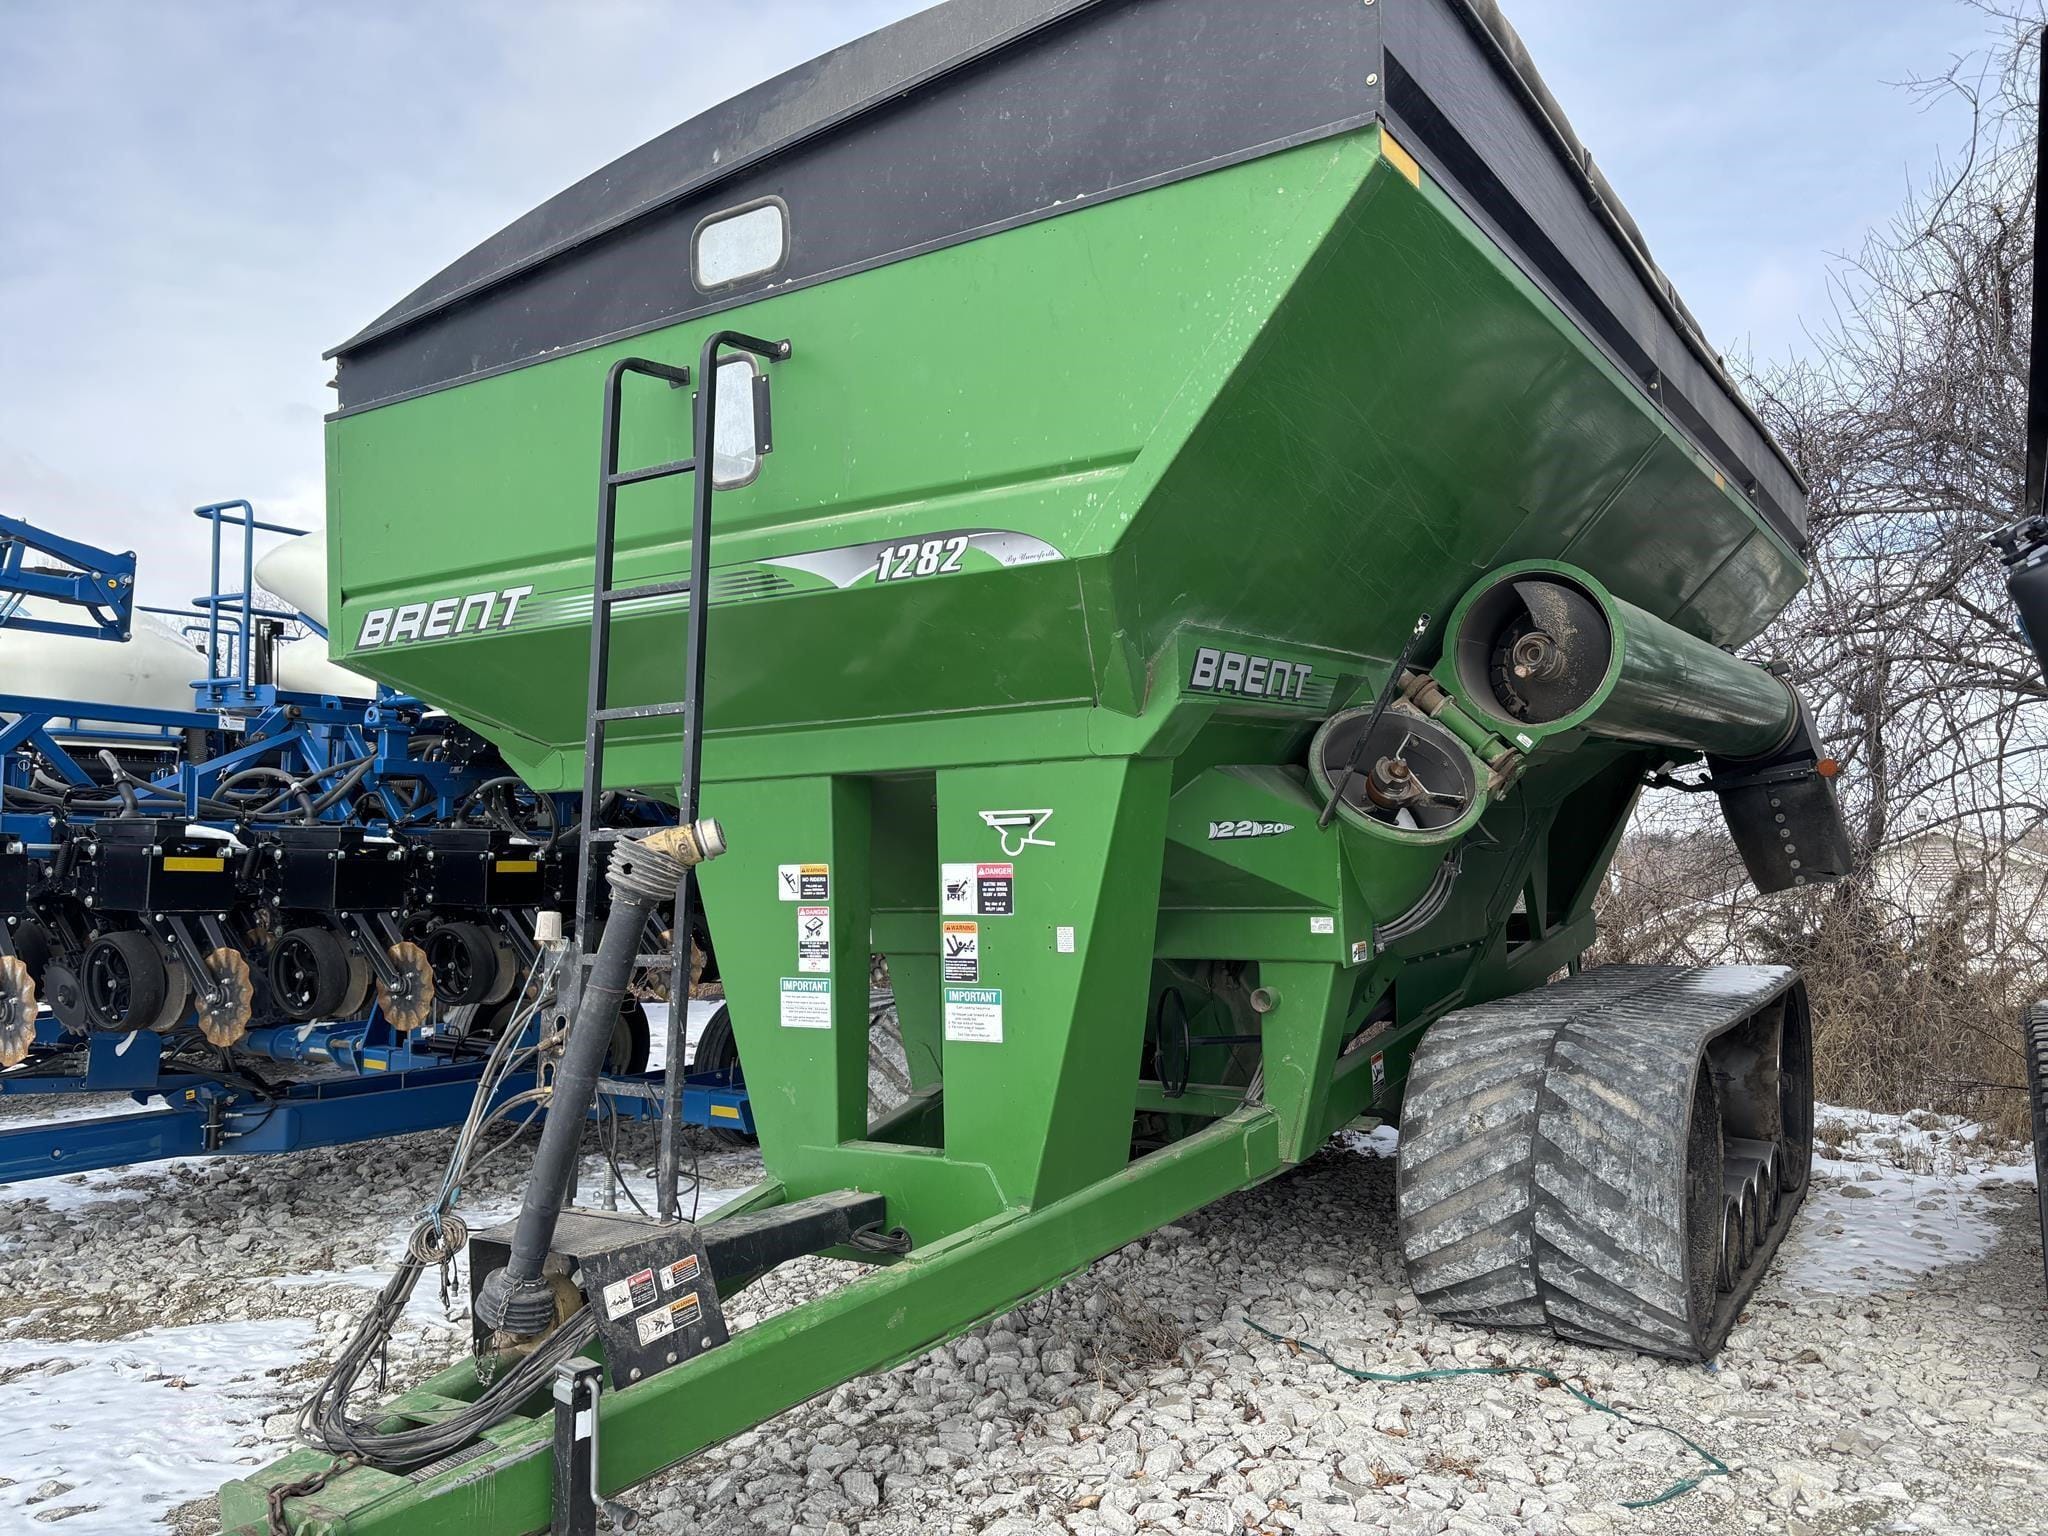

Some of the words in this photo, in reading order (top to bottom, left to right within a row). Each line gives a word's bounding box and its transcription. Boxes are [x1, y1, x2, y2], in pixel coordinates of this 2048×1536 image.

[876, 536, 969, 583] 1282
[355, 585, 534, 649] BRENT
[1188, 647, 1313, 701] BRENT
[984, 867, 1012, 875] DANGER
[783, 980, 828, 992] IMPORTANT
[949, 990, 997, 1003] IMPORTANT
